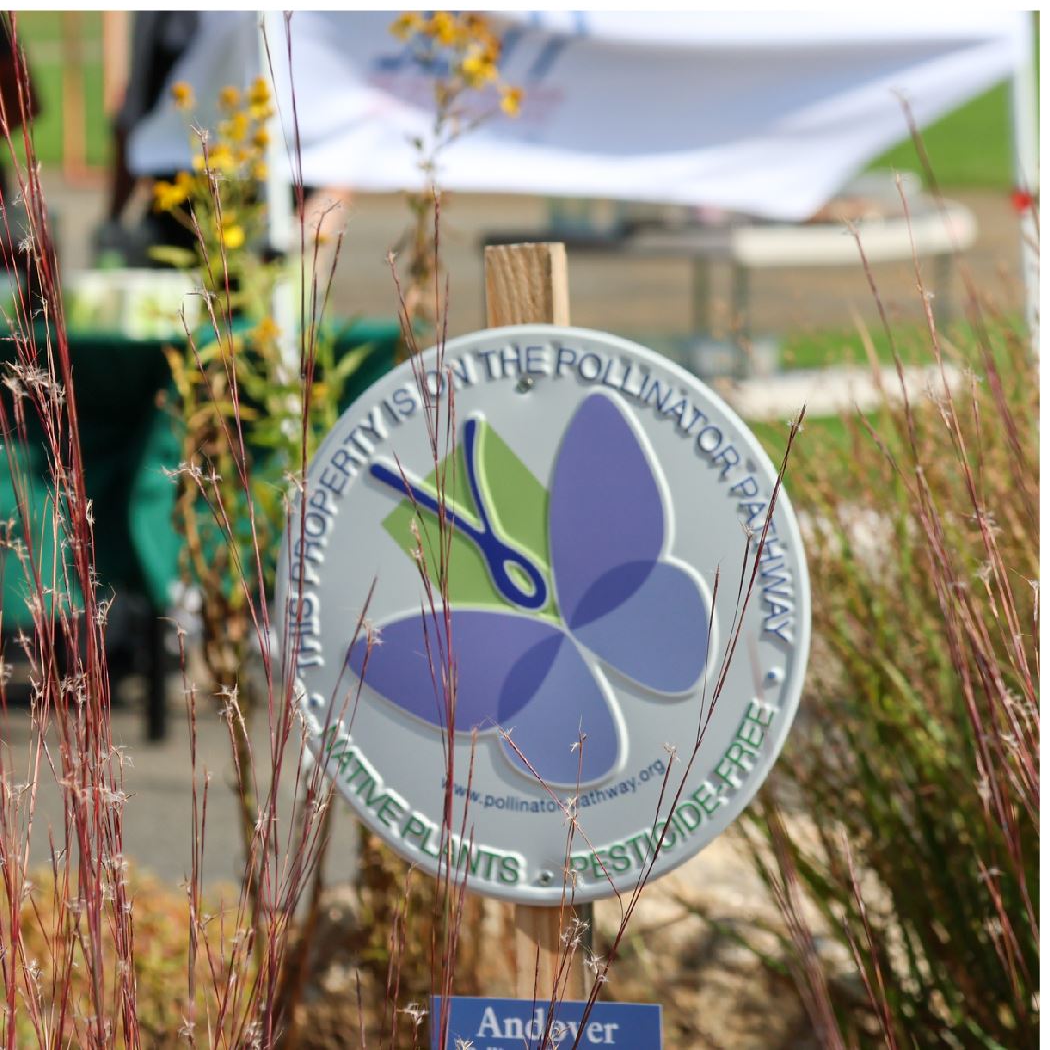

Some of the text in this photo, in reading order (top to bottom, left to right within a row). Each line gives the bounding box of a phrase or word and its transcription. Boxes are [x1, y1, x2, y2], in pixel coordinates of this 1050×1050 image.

[288, 343, 794, 679] THIS PROPERTY IS ON THE POLLINATOR PATHWAY
[317, 702, 775, 885] NATIVE PLANTS PESTICIDE-FREE
[476, 1005, 620, 1045] Andover
